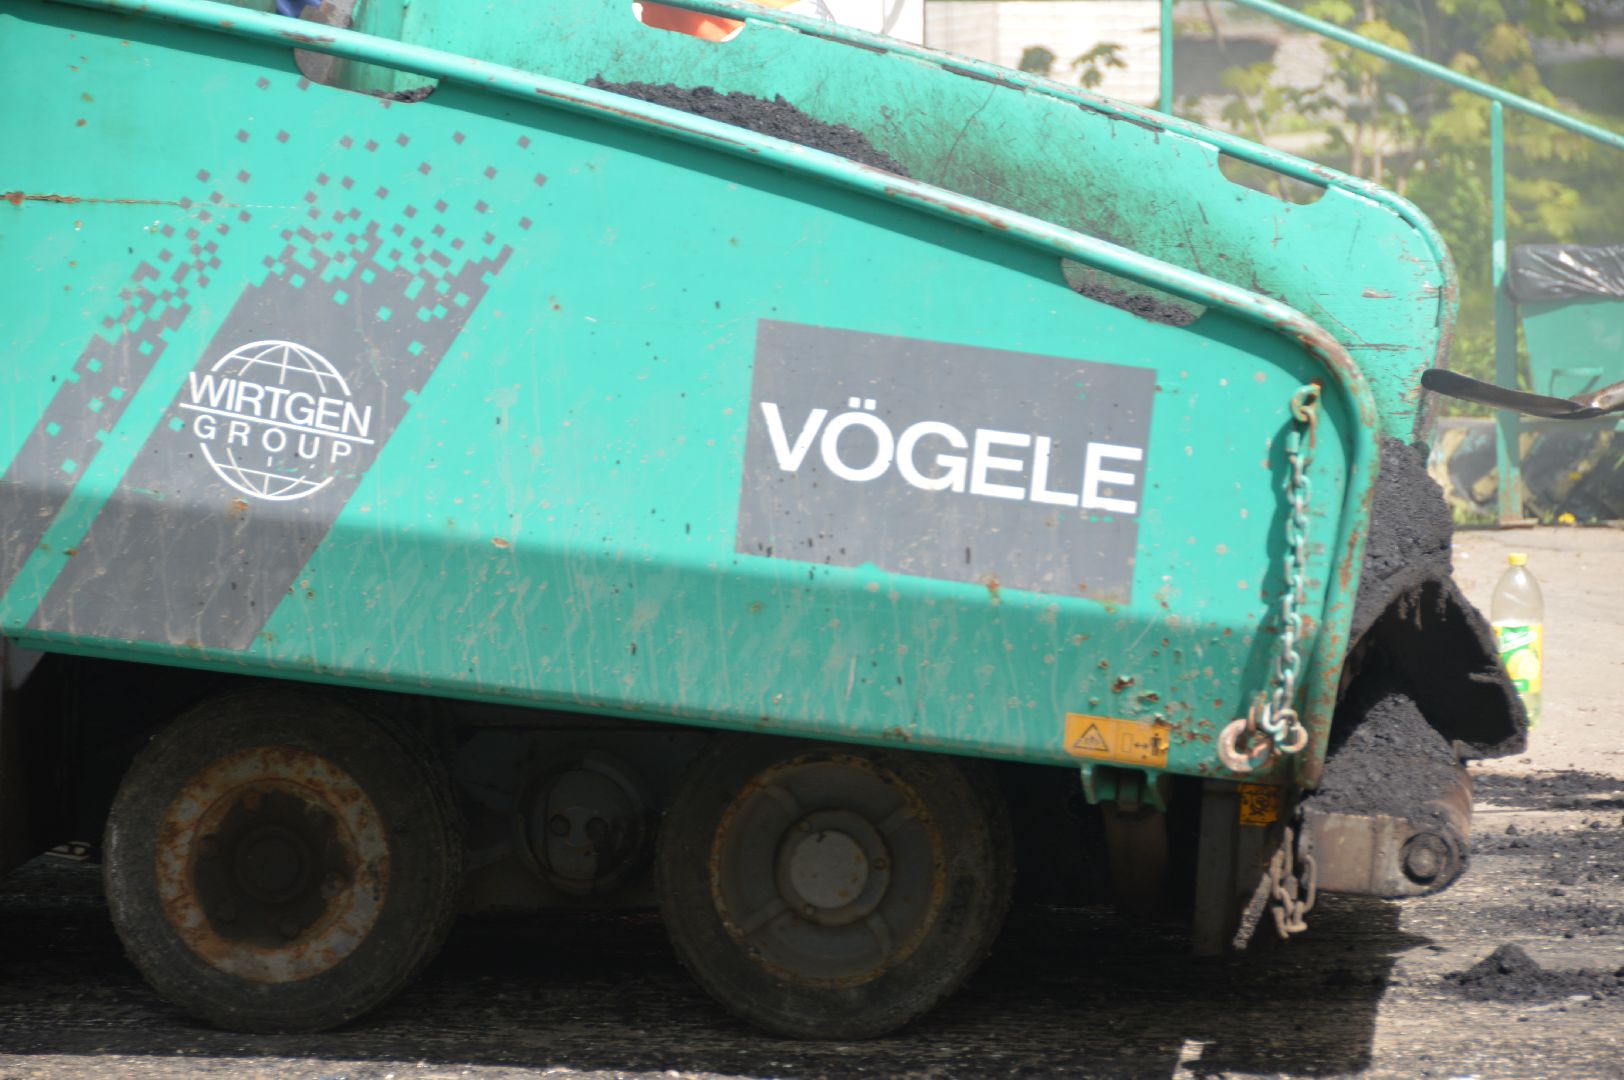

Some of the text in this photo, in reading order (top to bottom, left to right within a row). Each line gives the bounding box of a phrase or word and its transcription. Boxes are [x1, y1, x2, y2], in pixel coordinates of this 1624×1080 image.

[189, 371, 372, 437] WIRTGEN
[193, 414, 352, 463] GROUP
[760, 396, 1143, 514] VÖGELE
